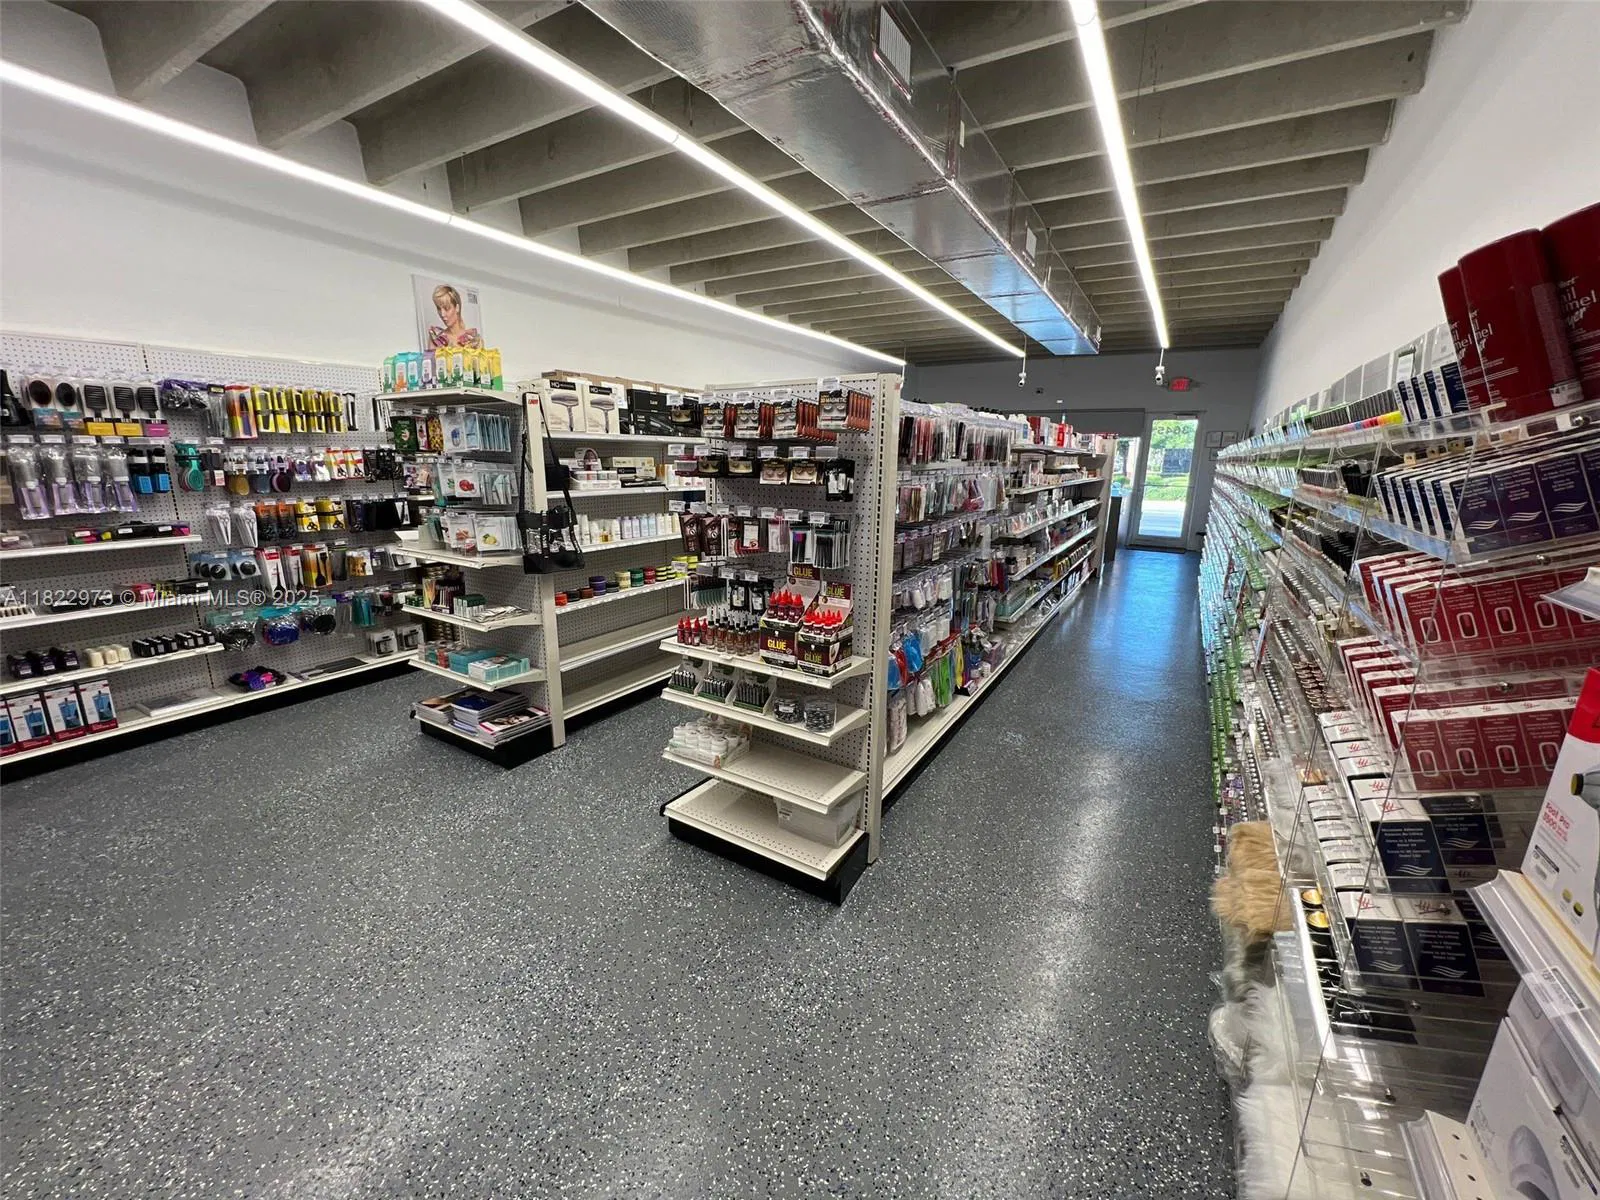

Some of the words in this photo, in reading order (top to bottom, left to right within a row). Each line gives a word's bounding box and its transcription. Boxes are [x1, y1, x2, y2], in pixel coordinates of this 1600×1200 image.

[793, 567, 813, 577] GLUE
[826, 586, 845, 596] GLUE
[767, 639, 787, 651] GLUE
[804, 653, 822, 664] GLUE
